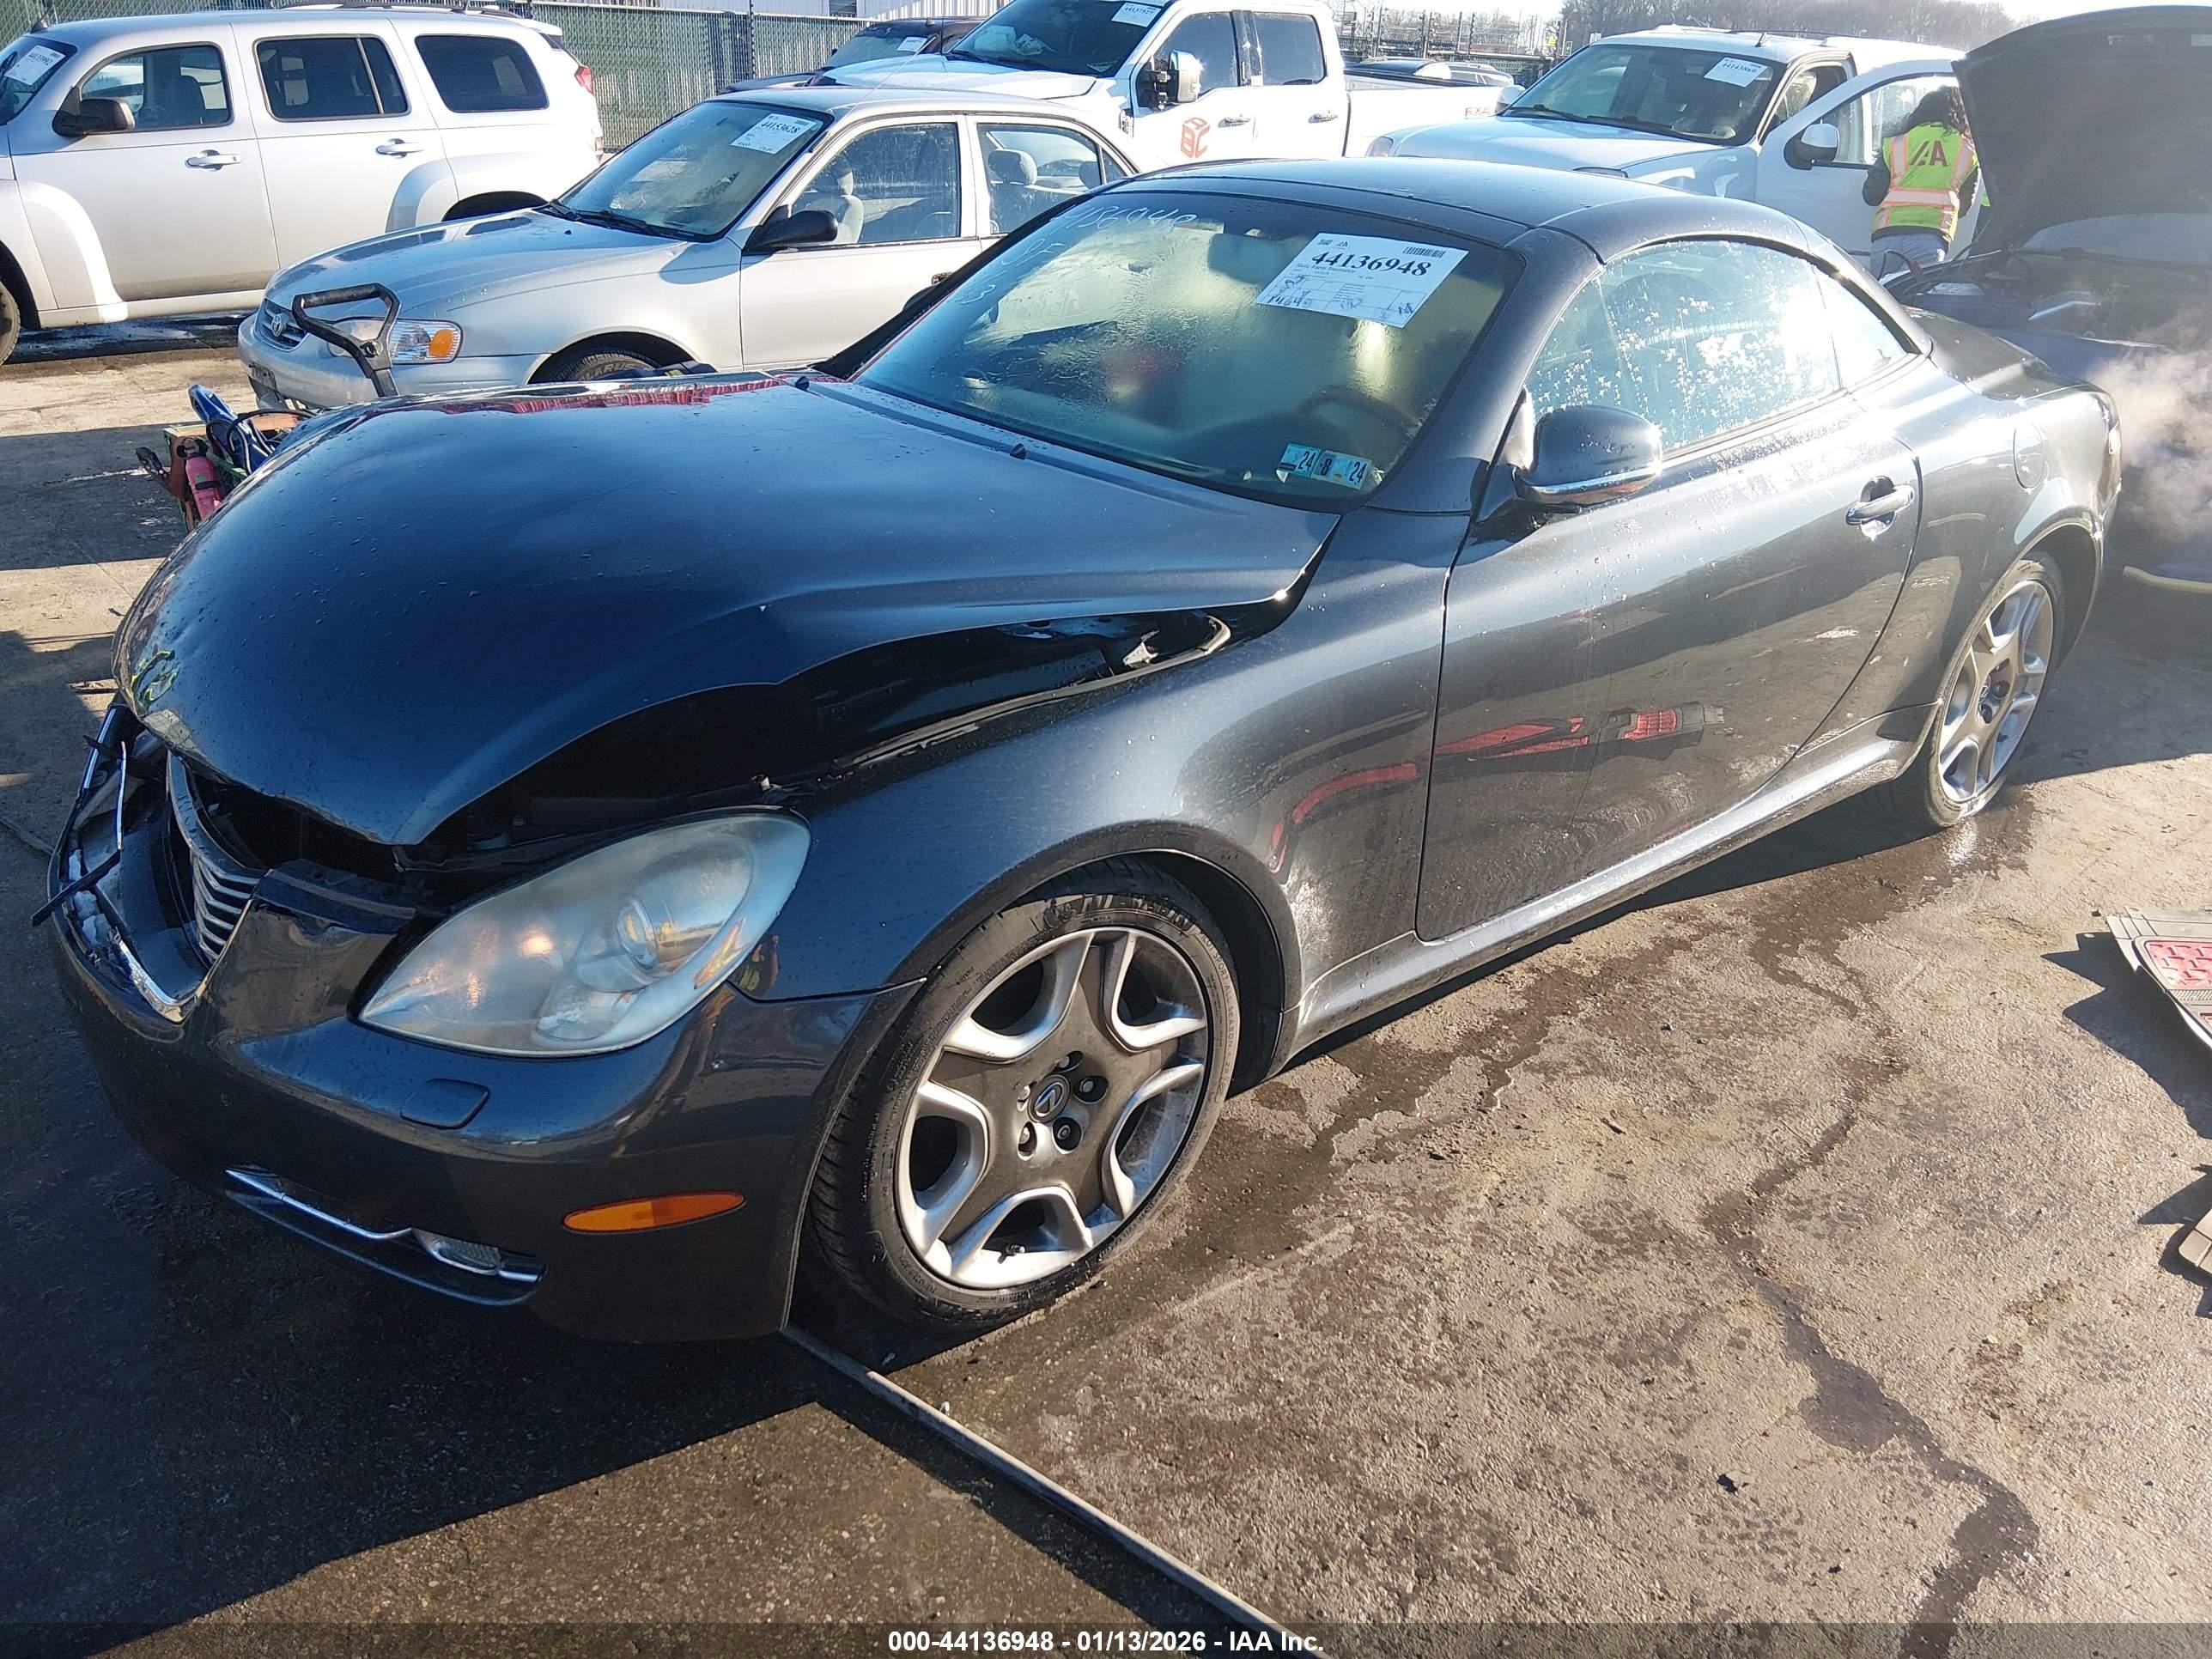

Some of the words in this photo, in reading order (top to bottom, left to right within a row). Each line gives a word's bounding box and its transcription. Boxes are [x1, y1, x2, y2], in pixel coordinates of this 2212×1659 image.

[1311, 251, 1432, 276] 44136948
[1297, 450, 1317, 471] 24
[1348, 461, 1367, 483] 24
[1213, 951, 1229, 981] SPORT
[1224, 985, 1233, 1003] ALL
